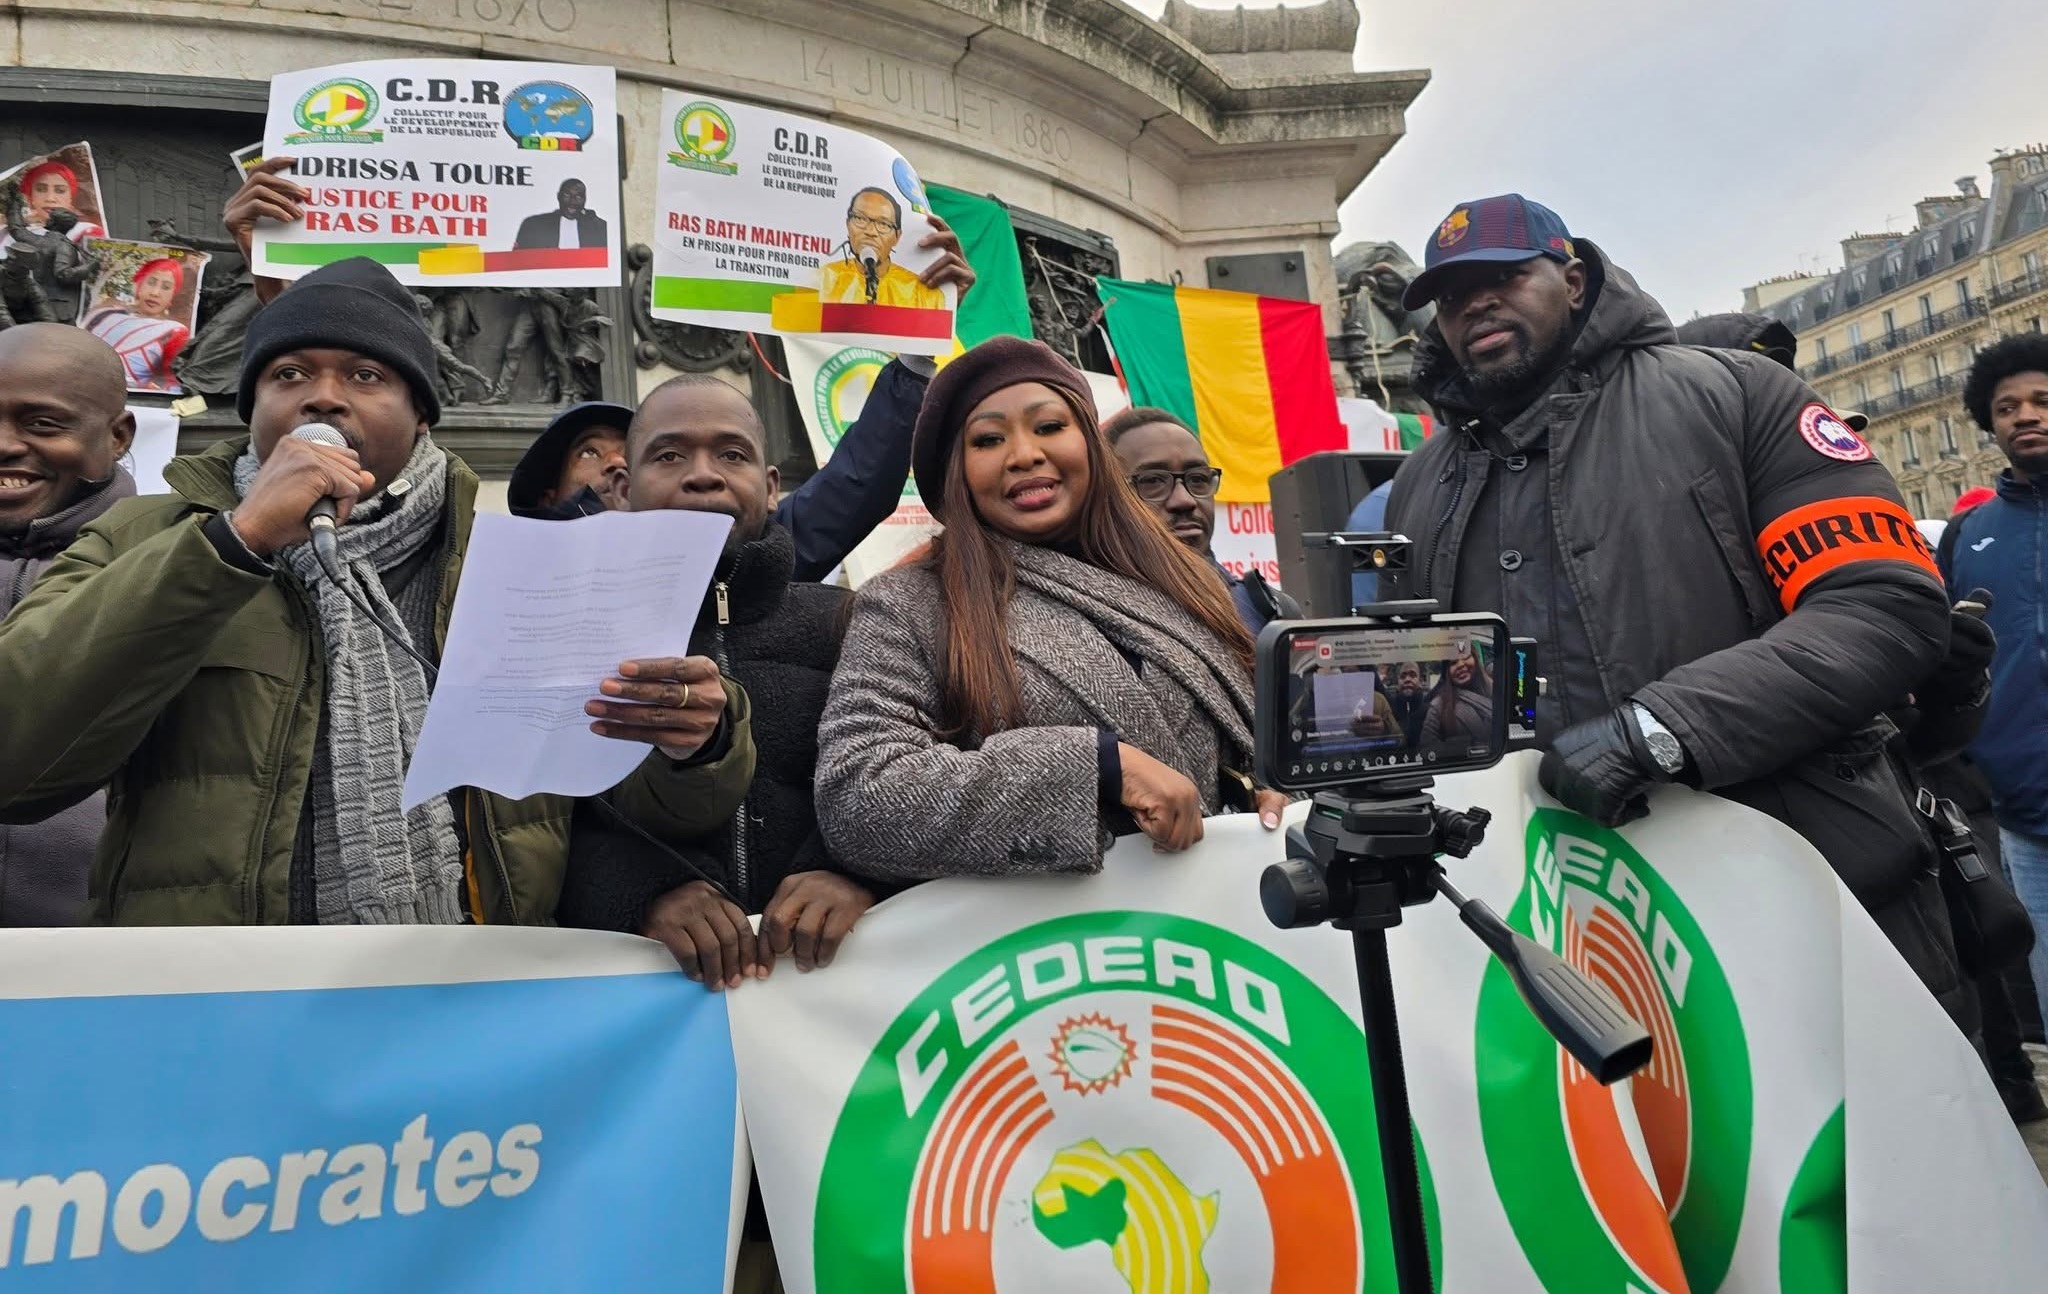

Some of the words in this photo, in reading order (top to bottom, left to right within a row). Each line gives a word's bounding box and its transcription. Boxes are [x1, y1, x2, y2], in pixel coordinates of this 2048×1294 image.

[386, 78, 500, 106] C.D.R
[800, 39, 834, 87] 14
[854, 57, 999, 135] JUILLET
[1012, 107, 1072, 162] 1880
[383, 117, 399, 125] LE
[401, 117, 499, 129] DEVELOPPEMENT
[393, 108, 455, 118] COLLECTIF
[458, 110, 488, 120] POUR
[390, 125, 405, 133] DE
[408, 126, 423, 134] LA
[426, 127, 497, 138] REPUBLIQUE
[774, 127, 828, 159] C.D.R
[290, 156, 421, 182] IDRISSA
[429, 162, 535, 187] TOURE
[762, 164, 771, 174] LE
[772, 166, 838, 186] DEVELOPPEMENT
[768, 152, 808, 169] COLLECTIF
[810, 160, 832, 172] POUR
[303, 187, 404, 210] USTICE
[412, 191, 488, 213] POUR
[763, 177, 774, 188] DE
[775, 179, 785, 190] LA
[787, 182, 836, 198] REPUBLIQUE
[305, 211, 379, 232] RAS
[391, 214, 488, 237] BATH
[668, 211, 701, 233] RAS
[705, 218, 746, 241] BATH
[751, 226, 831, 254] MAINTENU
[683, 236, 695, 249] EN
[698, 240, 736, 254] PRISON
[738, 245, 765, 260] POUR
[768, 251, 820, 269] PROROGER
[715, 258, 727, 270] LA
[730, 260, 790, 279] TRANSITION
[896, 936, 1290, 1118] CEDEAO
[0, 1113, 542, 1269] mocrates
